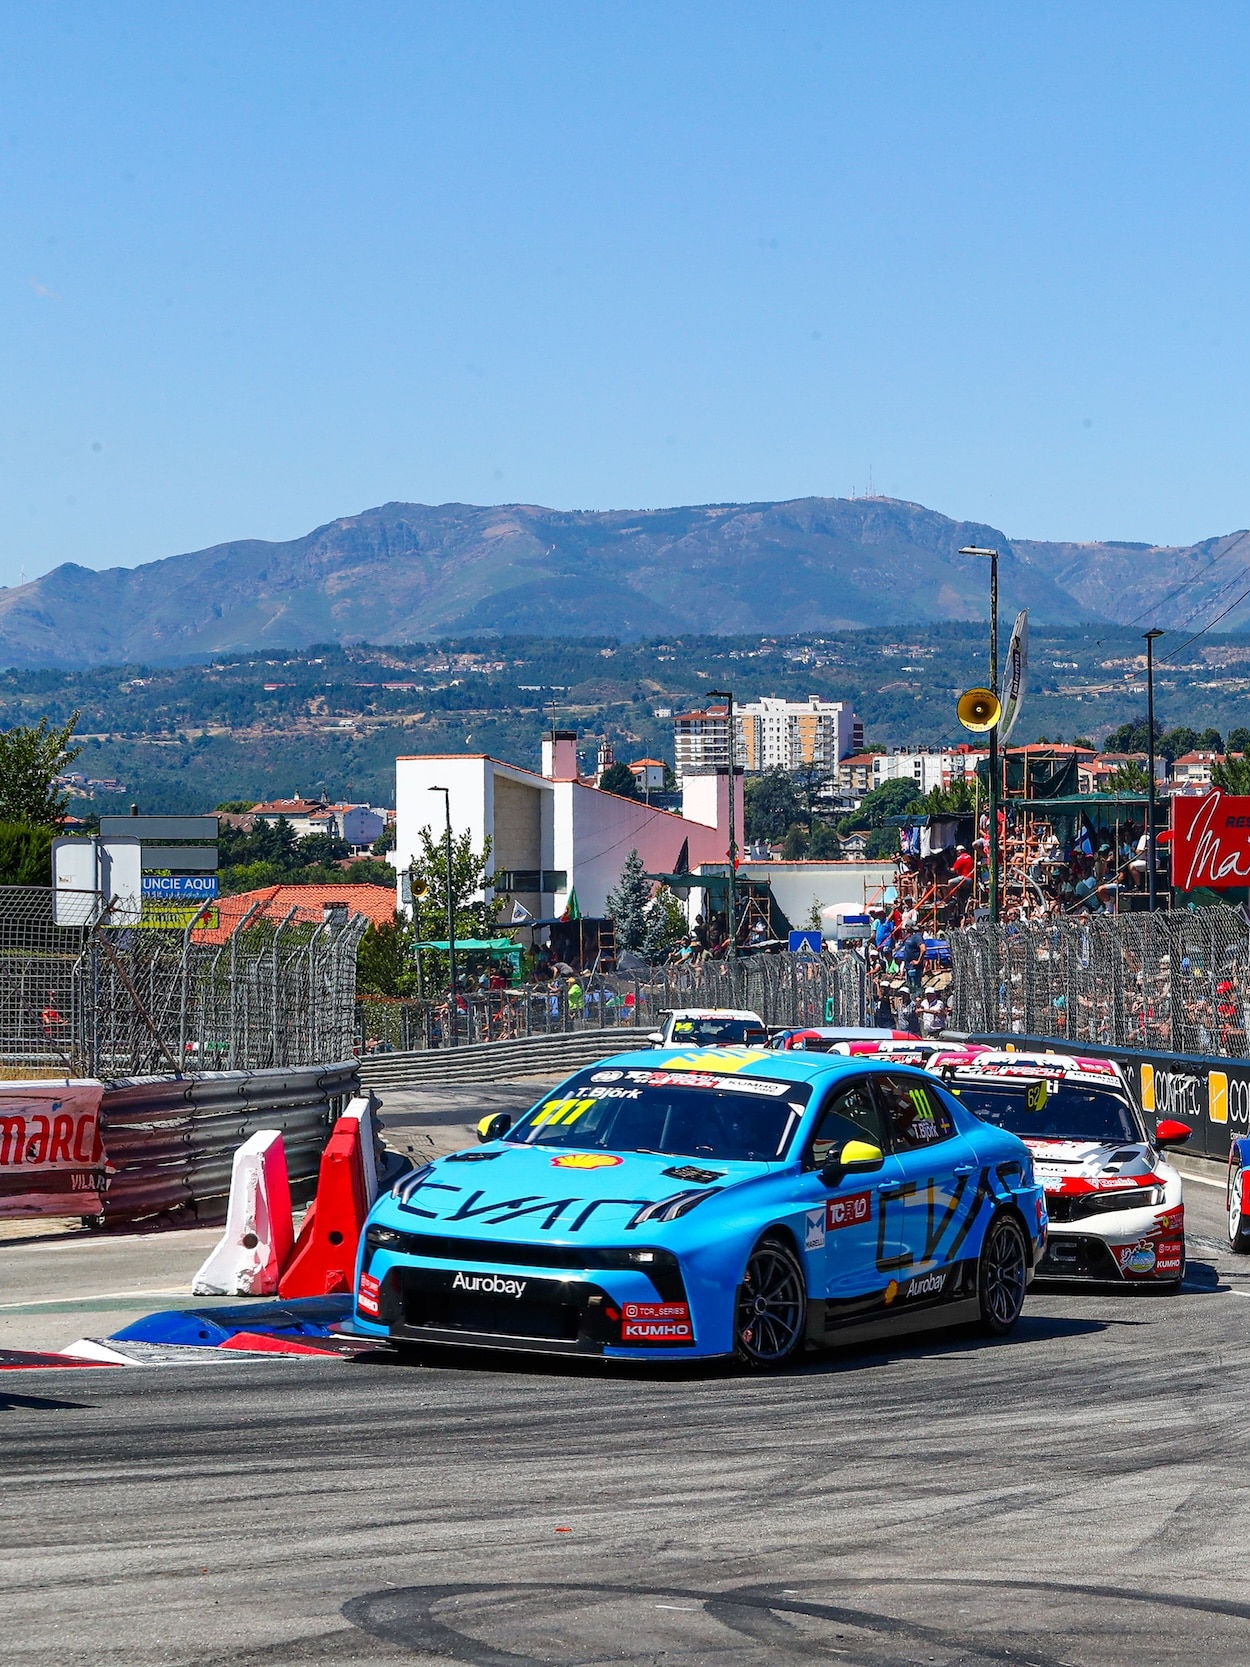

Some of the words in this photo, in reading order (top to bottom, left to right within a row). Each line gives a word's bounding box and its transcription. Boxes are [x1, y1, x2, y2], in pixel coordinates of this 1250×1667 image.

[143, 879, 181, 890] UNCIE
[184, 879, 216, 890] AQUI
[1157, 1259, 1181, 1269] KUMHO
[452, 1272, 527, 1299] Aurobay
[906, 1272, 947, 1299] Aurobay
[626, 1324, 689, 1336] KUMHO
